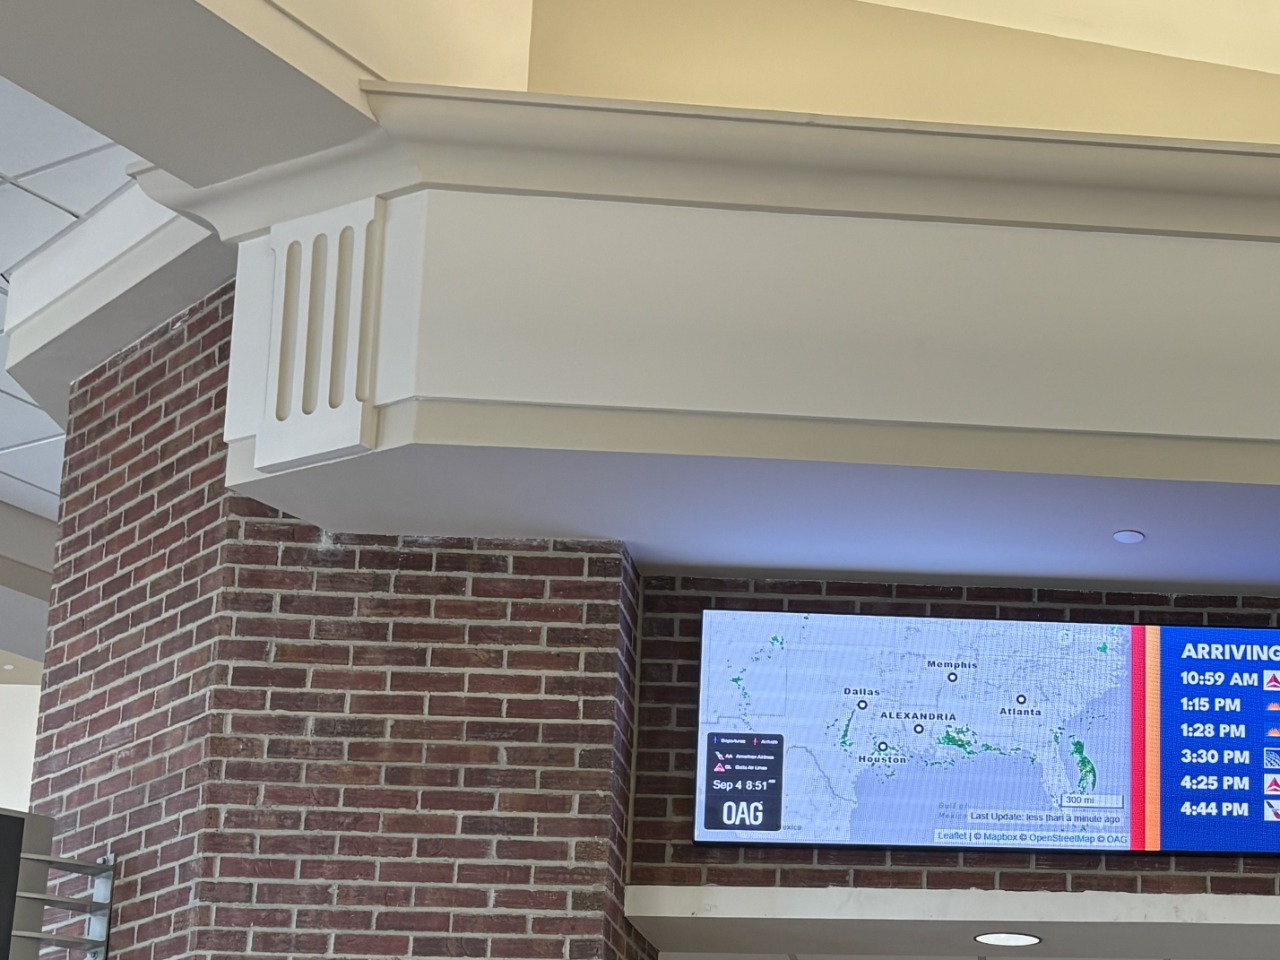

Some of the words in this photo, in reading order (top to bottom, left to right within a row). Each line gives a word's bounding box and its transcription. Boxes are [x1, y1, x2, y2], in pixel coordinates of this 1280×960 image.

[928, 660, 978, 669] Memphis
[1181, 671, 1224, 686] 10:59
[1230, 672, 1258, 687] AM
[844, 688, 880, 696] Dallas
[1181, 698, 1210, 712] 1:15
[1215, 699, 1241, 712] PM
[880, 712, 956, 721] ALEXANDRIA
[1000, 707, 1041, 716] Atlanta
[1181, 724, 1215, 738] 1:28
[1220, 725, 1245, 738] PM
[859, 755, 906, 764] Houston
[1181, 750, 1219, 764] 3:30
[1223, 751, 1250, 764] PM
[713, 780, 733, 791] Sep
[735, 780, 742, 789] 4
[746, 781, 767, 790] 8:51
[1181, 776, 1219, 790] 4:25
[1223, 777, 1249, 790] PM
[723, 801, 763, 825] OAG
[1181, 802, 1218, 816] 4:44
[1223, 803, 1248, 816] PM
[991, 813, 1024, 821] Update:
[938, 832, 967, 840] Leaflet
[984, 833, 1018, 841] Mapbox
[1029, 834, 1095, 844] OpenStreetMap
